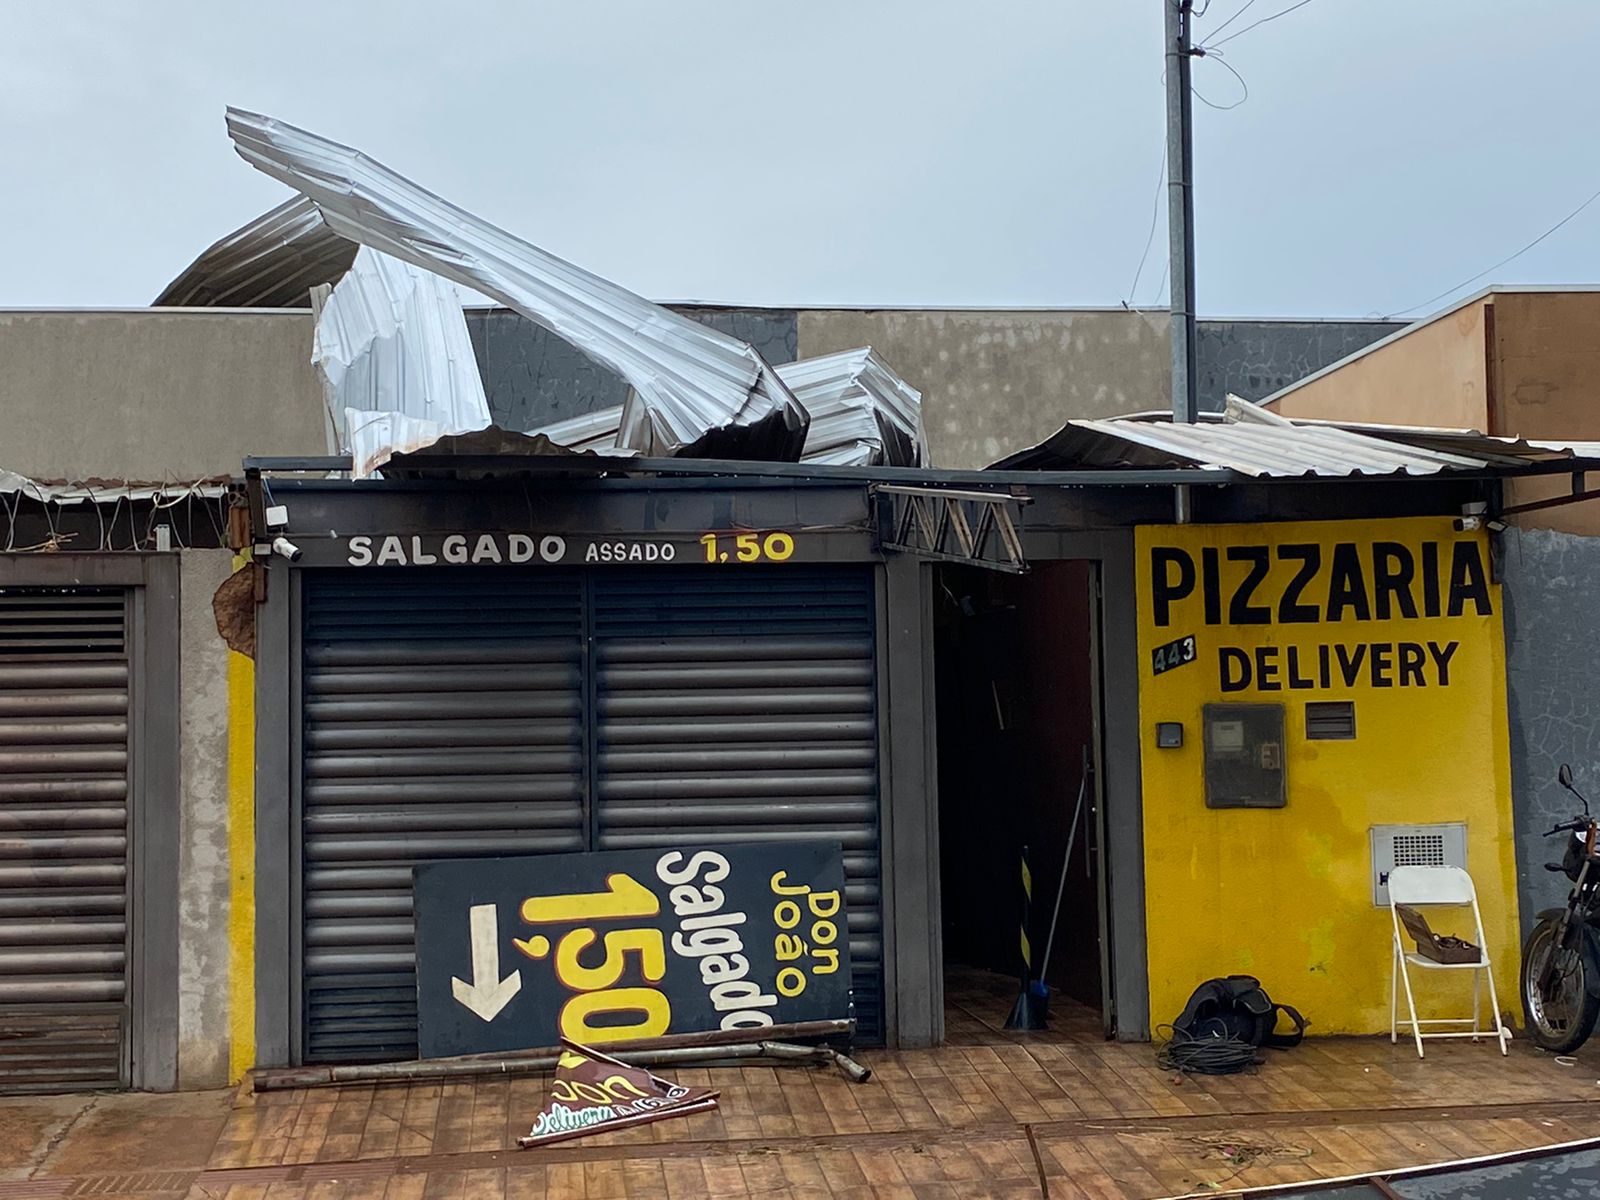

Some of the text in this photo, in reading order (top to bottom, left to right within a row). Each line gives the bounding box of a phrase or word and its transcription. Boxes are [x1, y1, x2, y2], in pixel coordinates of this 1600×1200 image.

[348, 532, 795, 566] SALGADO ASSADO 1,50
[1150, 540, 1493, 627] PIZZARIA
[1155, 637, 1194, 671] 443
[1218, 641, 1460, 693] DELIVERY
[513, 873, 671, 1047] 1,50
[656, 850, 778, 1031] Salgado
[770, 870, 811, 998] João
[808, 889, 840, 975] Don
